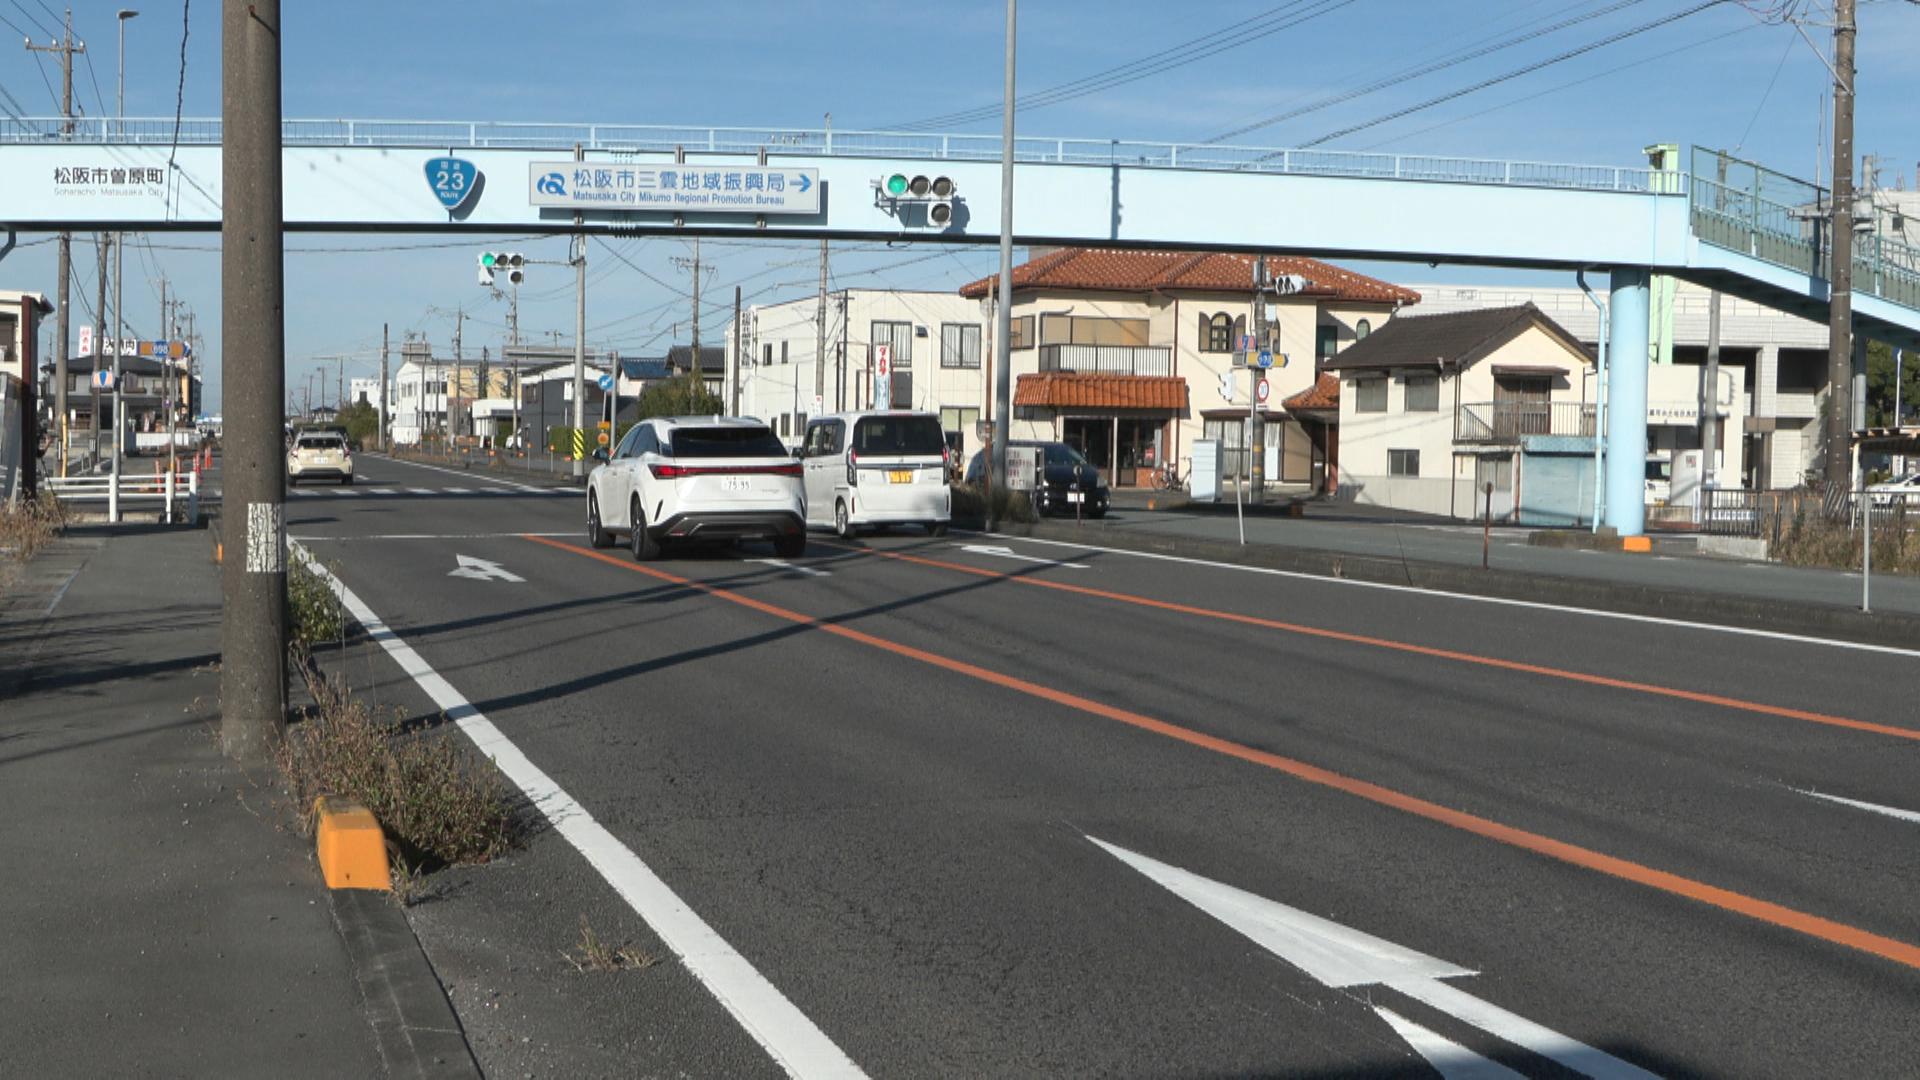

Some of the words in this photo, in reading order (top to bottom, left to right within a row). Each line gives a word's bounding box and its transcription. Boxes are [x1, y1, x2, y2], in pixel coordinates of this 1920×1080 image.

[436, 171, 464, 190] 23
[573, 168, 785, 192] 松阪市三雲地域振興局
[101, 187, 143, 197] Matsusaka
[148, 187, 164, 198] City
[573, 191, 617, 202] Matsusaka
[620, 191, 636, 204] City
[640, 192, 671, 203] Mikumo
[674, 192, 709, 205] Regional
[712, 193, 754, 205] Promotion
[756, 194, 785, 205] Bureau
